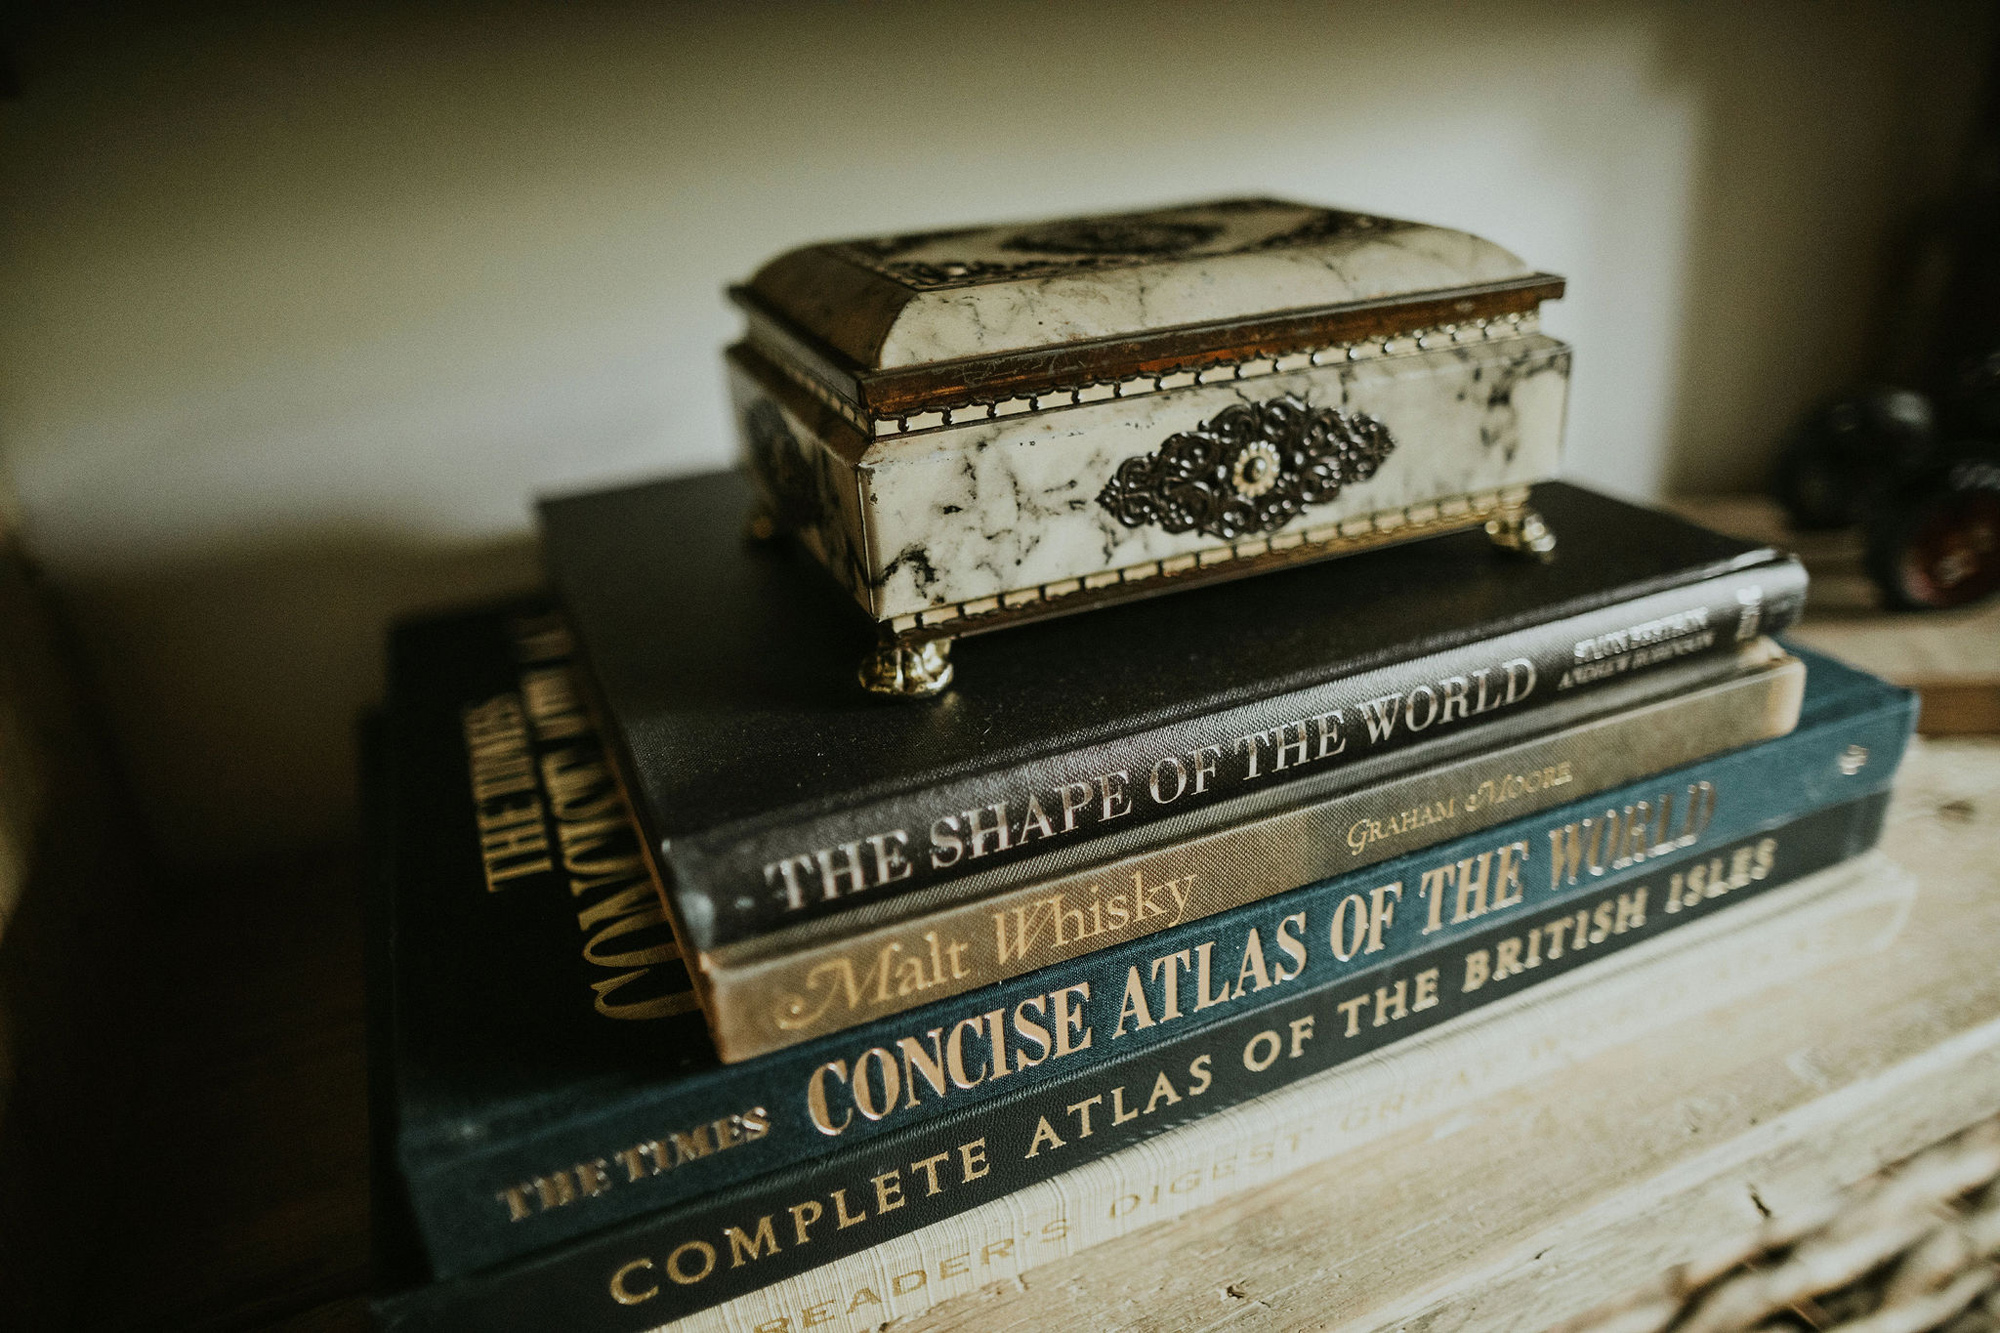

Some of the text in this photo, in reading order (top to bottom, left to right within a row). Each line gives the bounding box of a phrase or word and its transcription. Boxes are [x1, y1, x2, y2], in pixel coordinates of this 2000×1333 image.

[477, 793, 553, 892] THE
[765, 656, 1537, 911] THE SHAPE OF THE WORLD
[1347, 798, 1455, 856] GRAHAM
[773, 869, 1200, 1031] Malt Whisky
[806, 780, 1719, 1137] CONCISE ATLAS OF THE WORLD
[608, 1137, 992, 1306] COMPLETE
[1027, 1051, 1215, 1160] ATLAS
[1243, 1014, 1317, 1075] OF
[1338, 965, 1441, 1039] THE
[1462, 886, 1650, 993] BRITISH
[1666, 835, 1778, 917] ISLES
[496, 1106, 771, 1224] THE TIMES
[1108, 1125, 1315, 1222] DIGEST
